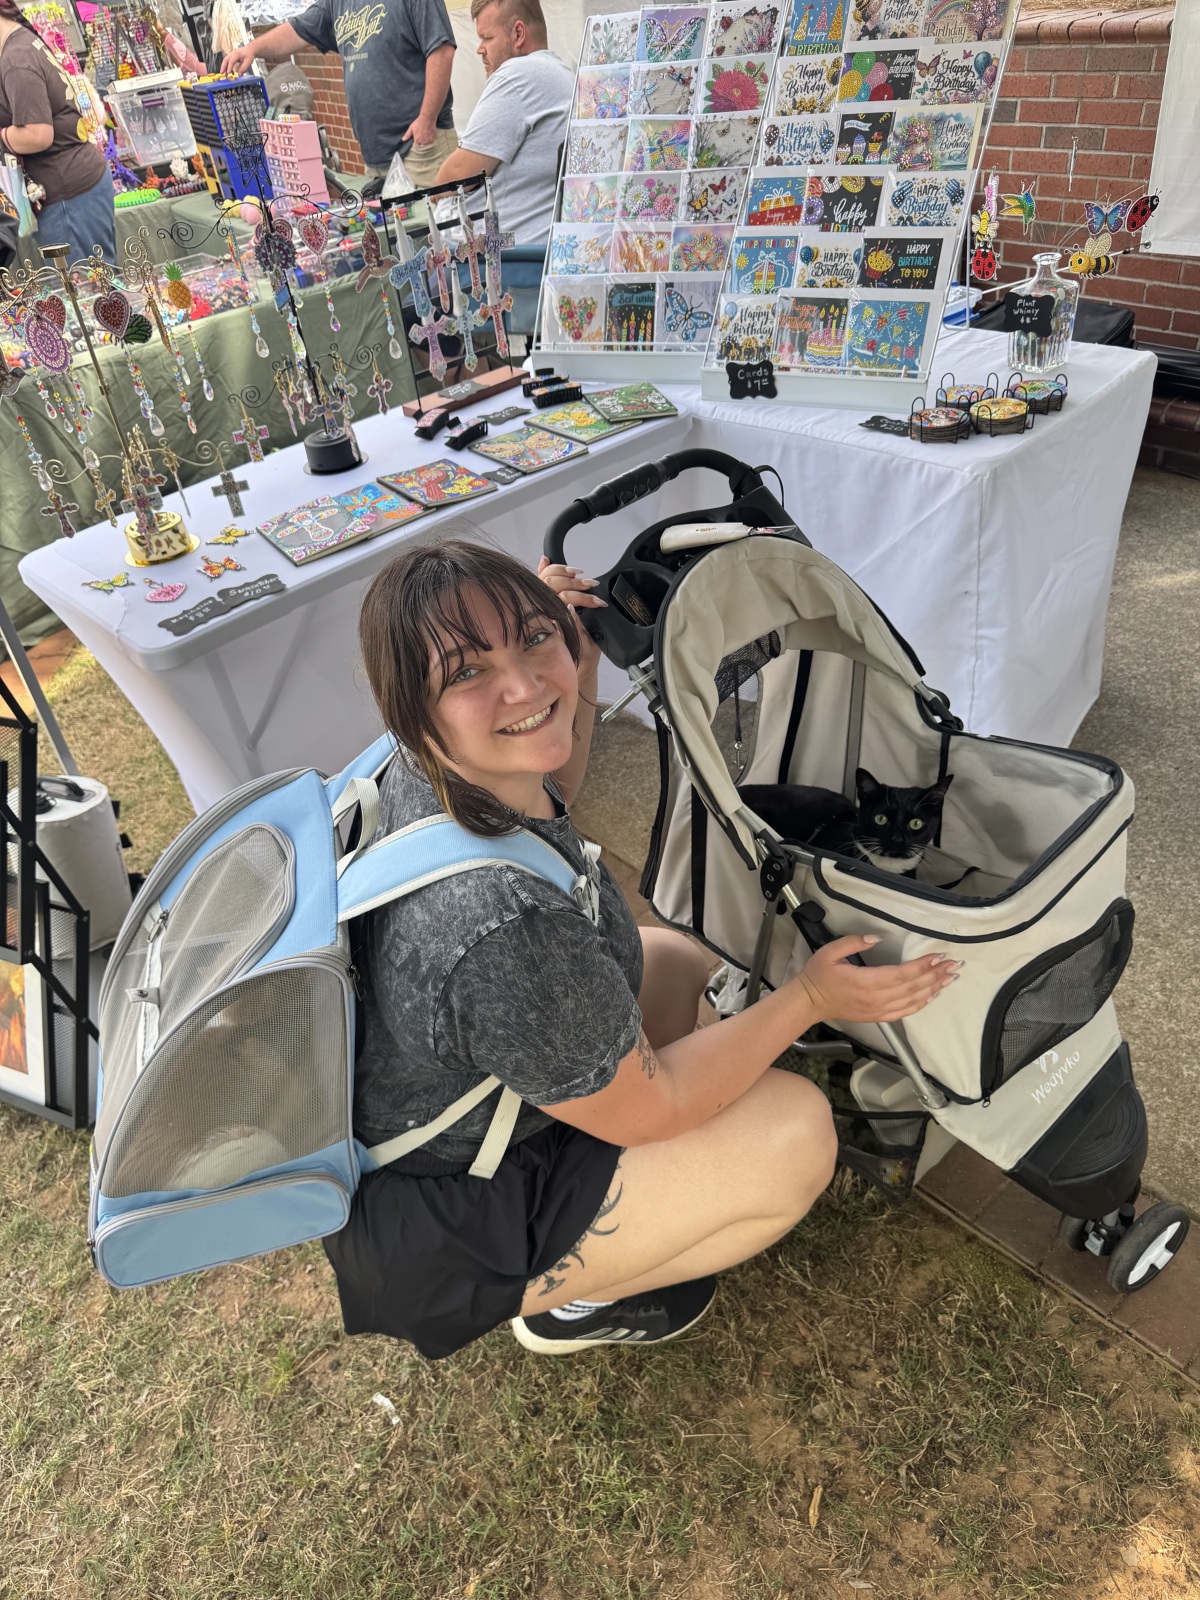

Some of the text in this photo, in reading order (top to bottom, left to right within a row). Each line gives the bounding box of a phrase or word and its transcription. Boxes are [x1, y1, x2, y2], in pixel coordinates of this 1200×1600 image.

[884, 3, 919, 22] Birthday
[926, 20, 966, 42] Birthday
[797, 43, 840, 55] BIRTHDA
[795, 64, 824, 81] Happy
[938, 58, 975, 77] Happy
[786, 79, 826, 99] Birthday
[930, 75, 977, 92] Birthday
[785, 122, 813, 138] Happy
[940, 119, 966, 136] Happy
[777, 135, 816, 155] Birthday
[939, 137, 970, 152] Birthday
[916, 184, 941, 197] HAPPY
[902, 196, 948, 218] Birthday
[740, 239, 797, 249] HAPPY BIRTHDA
[906, 244, 930, 254] HAPPY
[823, 252, 849, 262] HAPPY
[898, 256, 934, 267] BIRTHDAY
[811, 261, 855, 282] Birthday
[900, 268, 929, 278] TO YOU
[1017, 299, 1036, 307] Plant
[739, 305, 770, 324] Happy
[731, 321, 774, 340] Birthday
[737, 367, 769, 379] Cards
[229, 577, 278, 596] Suncatcher
[1031, 1051, 1080, 1104] Wedyvko
